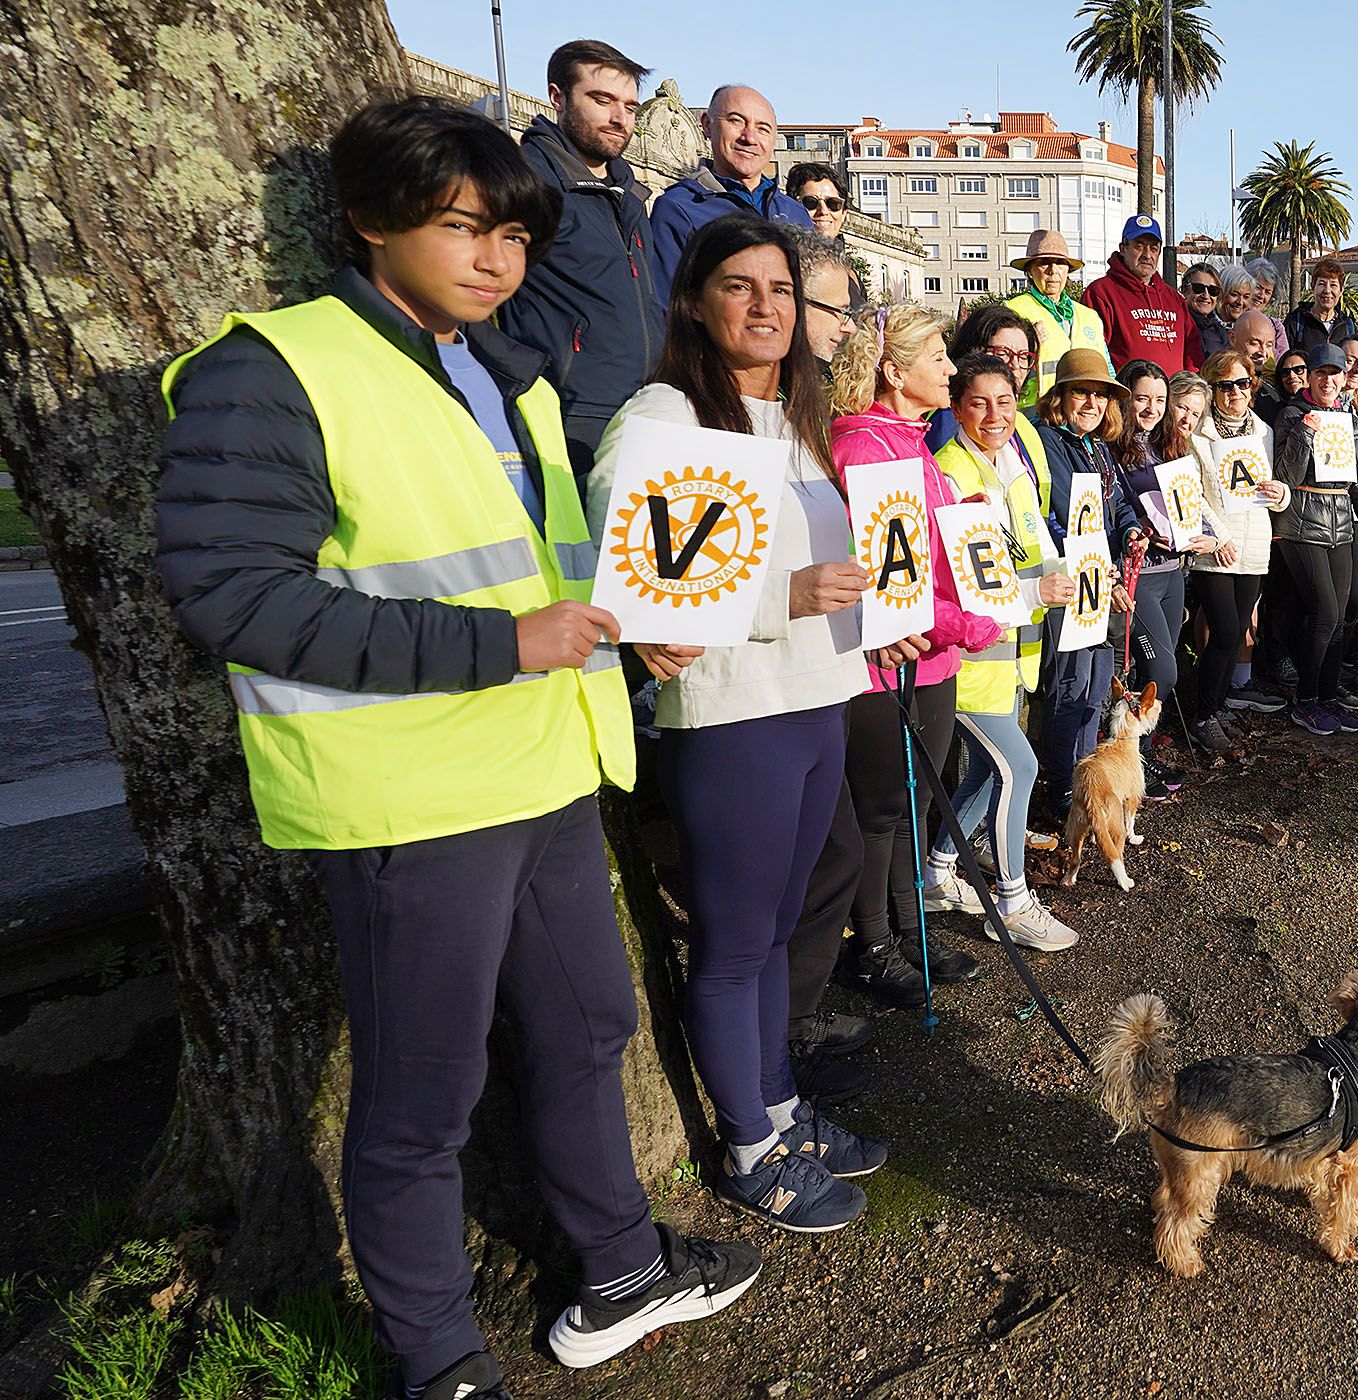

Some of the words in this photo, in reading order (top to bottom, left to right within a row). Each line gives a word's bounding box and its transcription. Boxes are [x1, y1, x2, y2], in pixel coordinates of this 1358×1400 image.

[671, 481, 734, 501] ROTARY
[1230, 459, 1256, 490] A
[884, 504, 915, 520] ROTARY
[1173, 489, 1183, 522] I
[647, 495, 728, 580] V
[877, 517, 918, 591] A
[633, 557, 741, 593] INTERNATIONAL
[967, 541, 1003, 591] E
[1078, 567, 1099, 616] N
